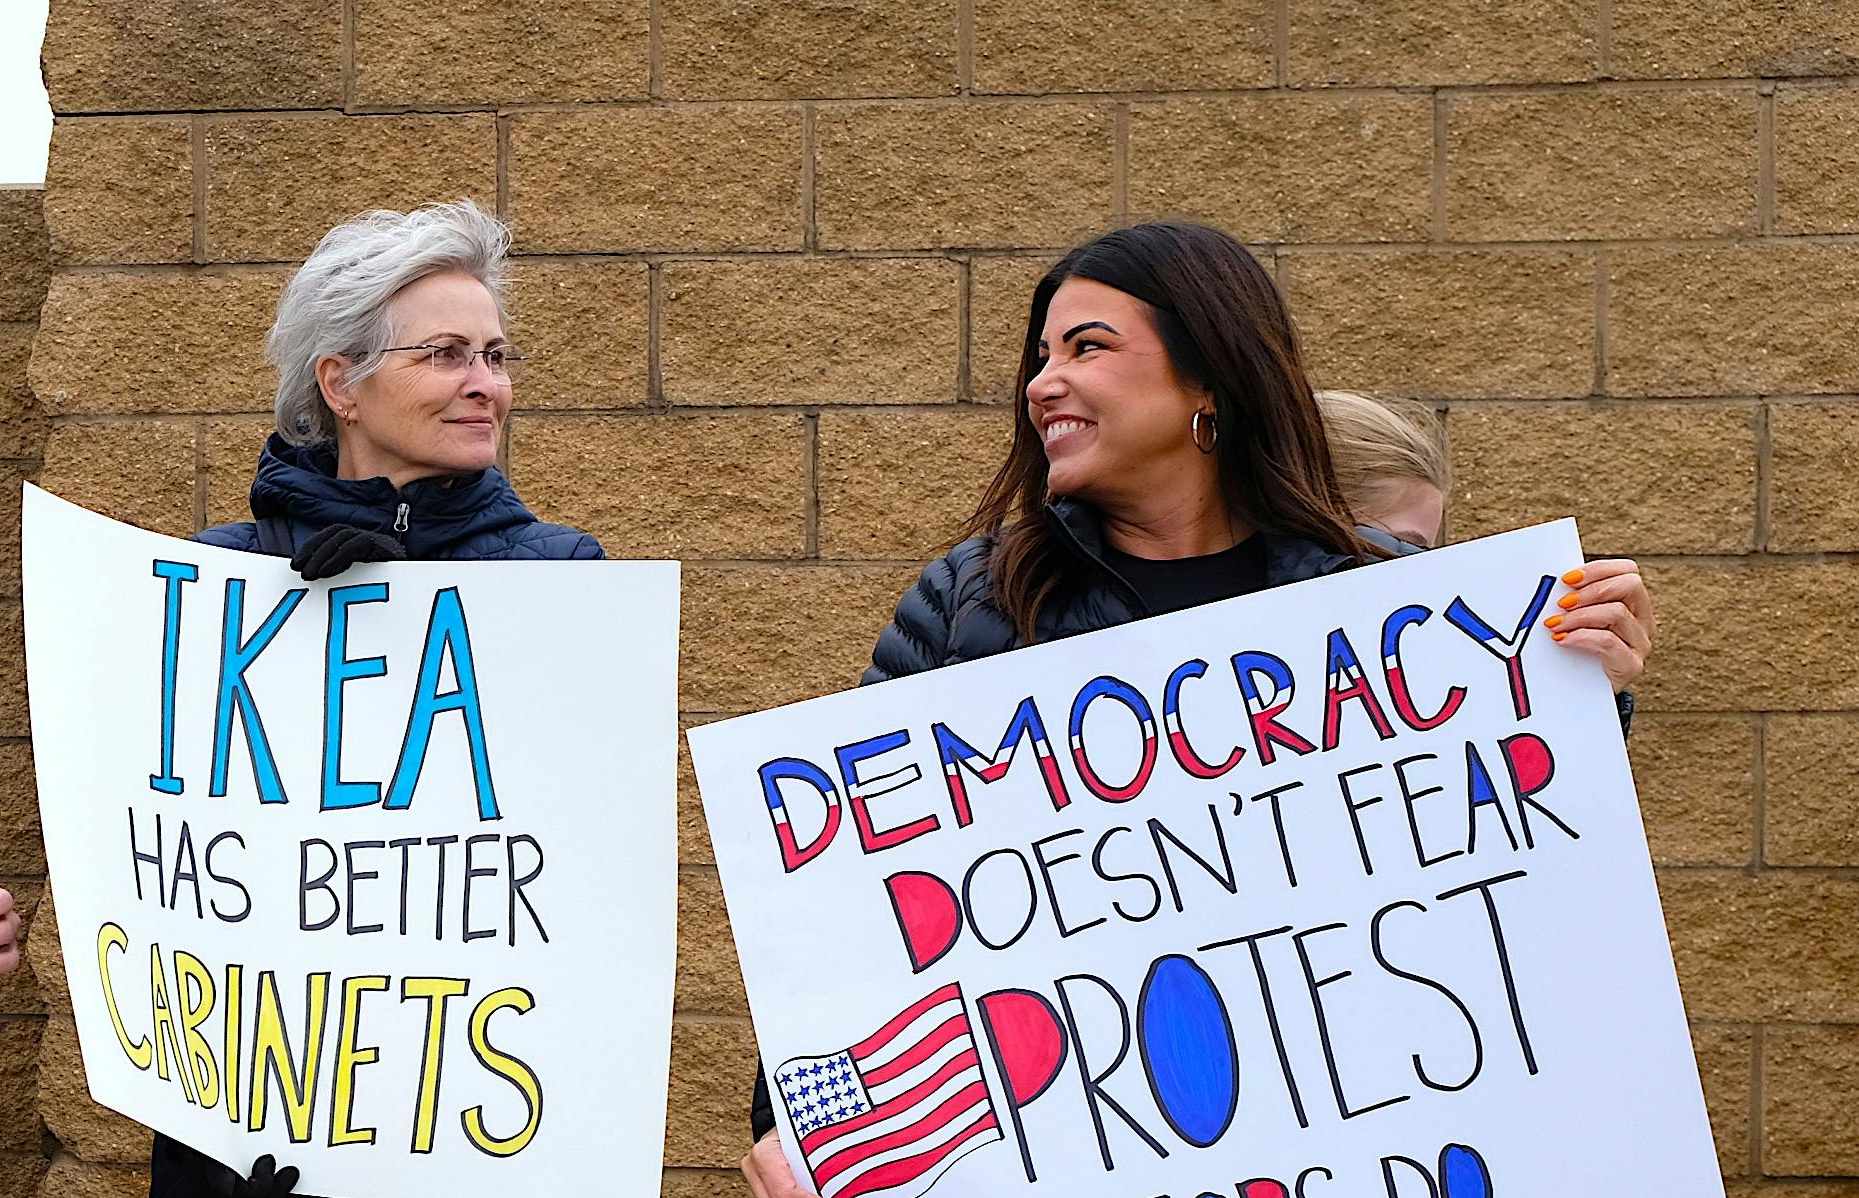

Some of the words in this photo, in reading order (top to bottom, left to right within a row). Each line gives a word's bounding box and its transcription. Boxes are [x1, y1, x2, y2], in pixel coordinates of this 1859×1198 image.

[149, 559, 503, 822] IKEA
[757, 575, 1557, 875] DEMOCRACY
[128, 807, 251, 922] HAS
[299, 834, 549, 947] BETTER
[883, 781, 1304, 975] DOESN'T
[1338, 733, 1580, 875] FEAR
[97, 922, 543, 1158] CABINETS
[975, 870, 1538, 1183] PROTEST
